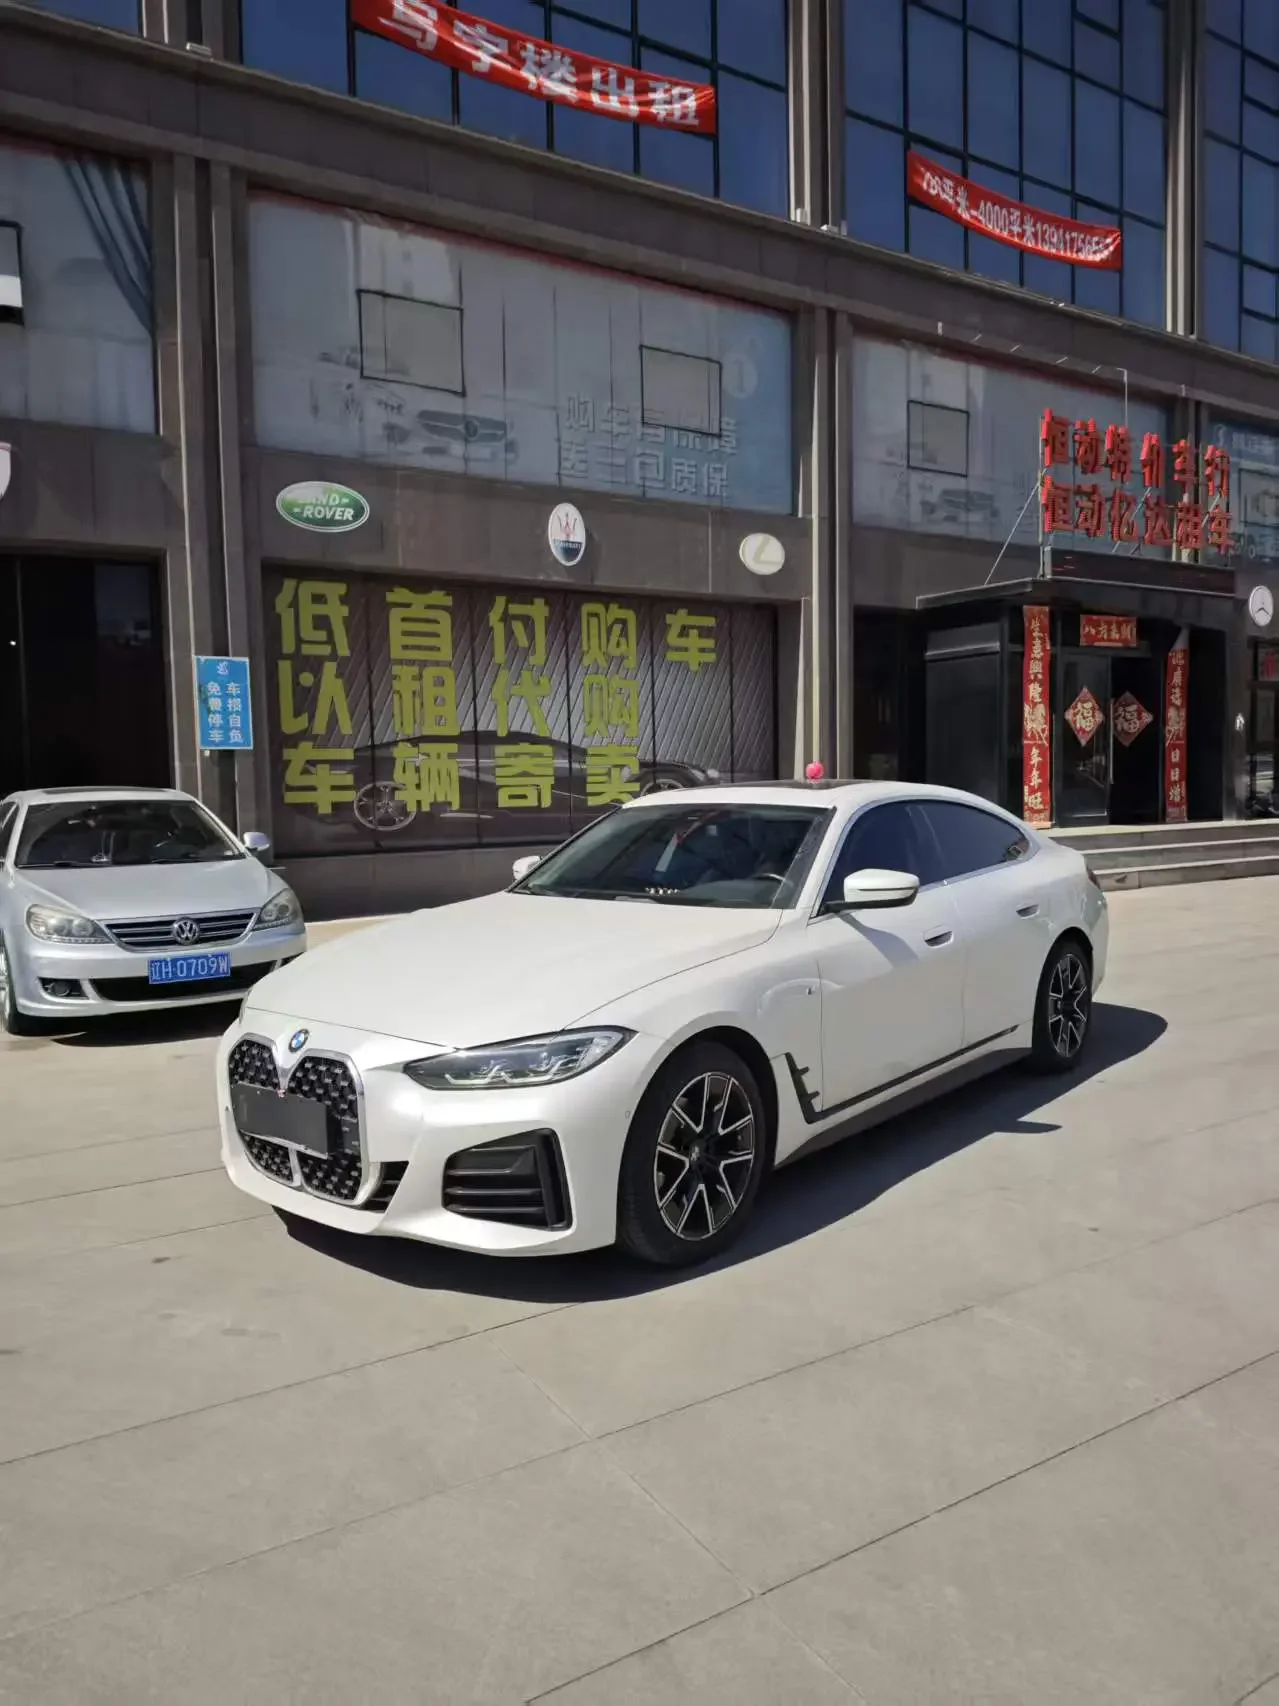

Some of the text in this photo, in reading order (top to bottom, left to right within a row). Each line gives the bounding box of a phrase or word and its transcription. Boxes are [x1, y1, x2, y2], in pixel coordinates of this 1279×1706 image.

[303, 505, 355, 521] ROVER
[274, 577, 718, 672] 低首付购车
[276, 660, 640, 737] 以租代购
[1074, 700, 1094, 732] 福
[1116, 704, 1140, 733] 福
[282, 741, 641, 815] 车辆寄卖
